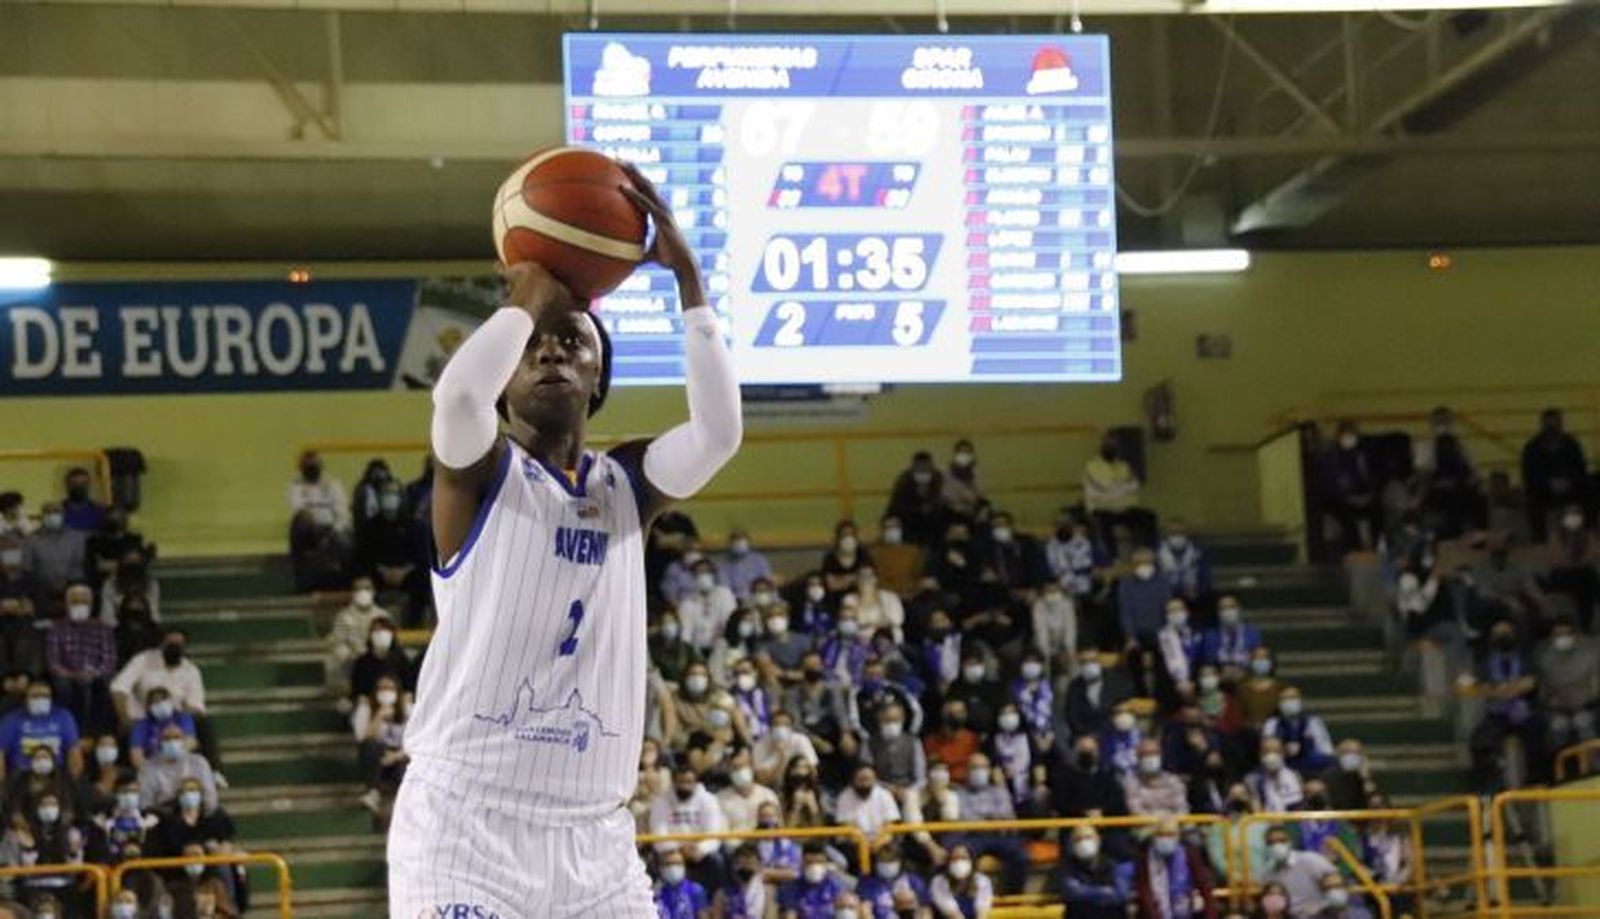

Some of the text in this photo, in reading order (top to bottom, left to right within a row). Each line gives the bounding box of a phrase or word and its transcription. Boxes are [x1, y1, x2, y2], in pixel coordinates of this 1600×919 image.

[741, 98, 814, 157] 67
[817, 164, 871, 202] 4T
[764, 236, 929, 291] 01:35
[10, 303, 386, 379] DE EUROPA
[773, 302, 807, 347] 2
[891, 301, 924, 346] 5
[558, 599, 584, 657] 2
